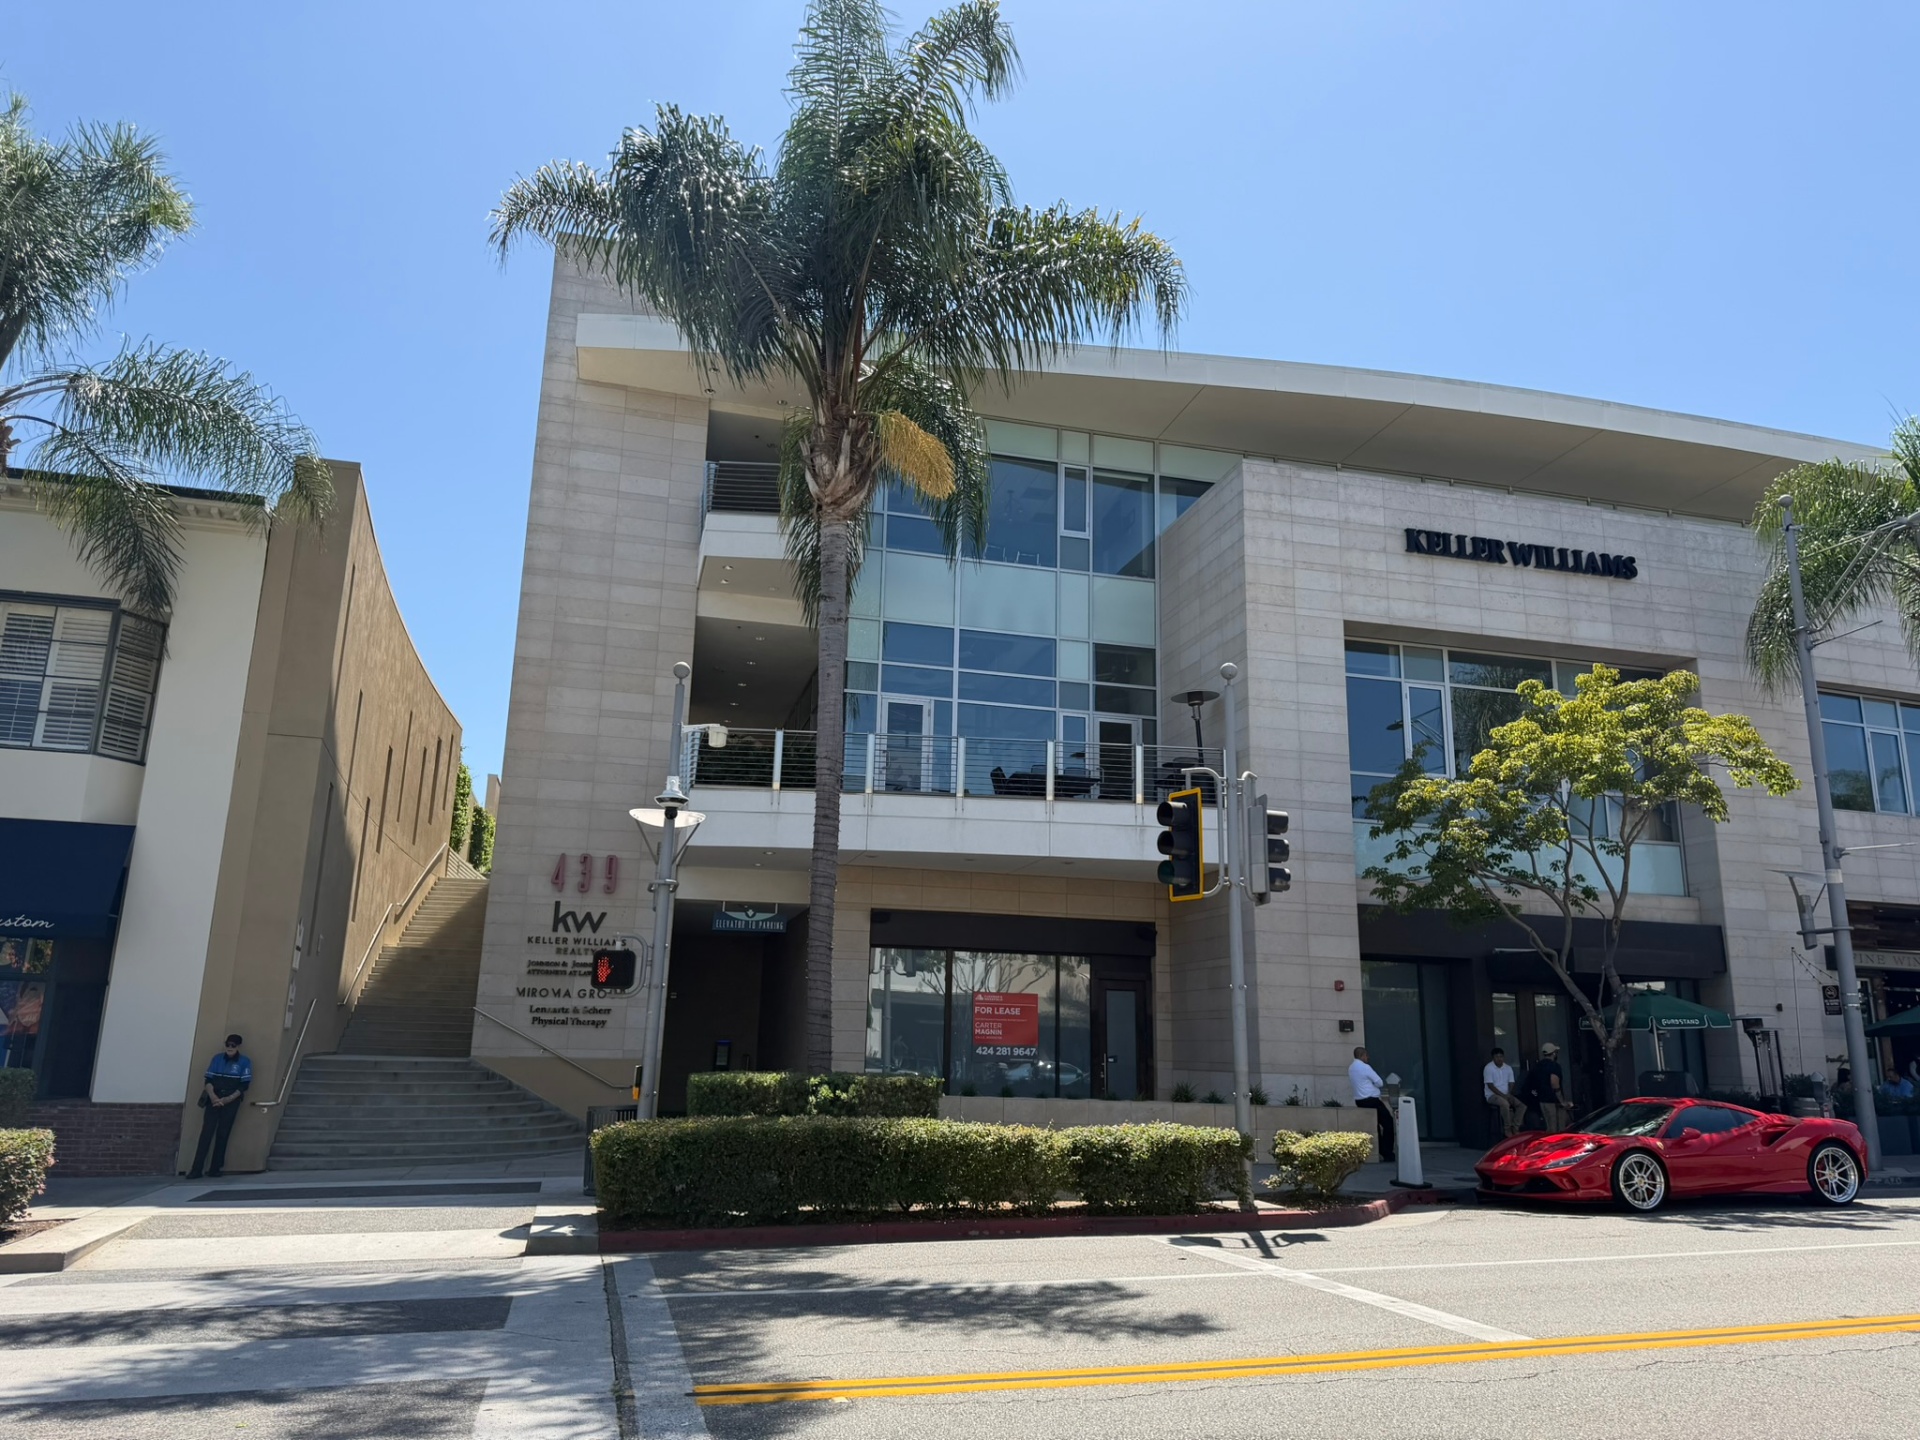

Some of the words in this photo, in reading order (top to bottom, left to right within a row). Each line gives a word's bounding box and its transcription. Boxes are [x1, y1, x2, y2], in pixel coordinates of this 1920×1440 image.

[1404, 528, 1508, 564] KELLER
[1506, 541, 1638, 580] WILLIAMS
[551, 853, 618, 894] 439
[552, 901, 607, 933] kw
[715, 919, 745, 929] ELEVATOR
[748, 920, 756, 929] TO
[758, 921, 784, 930] PARKING
[527, 936, 569, 945] KELLER
[974, 1006, 993, 1014] FOR
[994, 1007, 1021, 1015] LEASE
[531, 1016, 568, 1027] Physical
[570, 1017, 607, 1029] Therapy
[975, 1046, 994, 1055] 424
[996, 1047, 1010, 1055] 281
[1012, 1047, 1036, 1056] 9647
